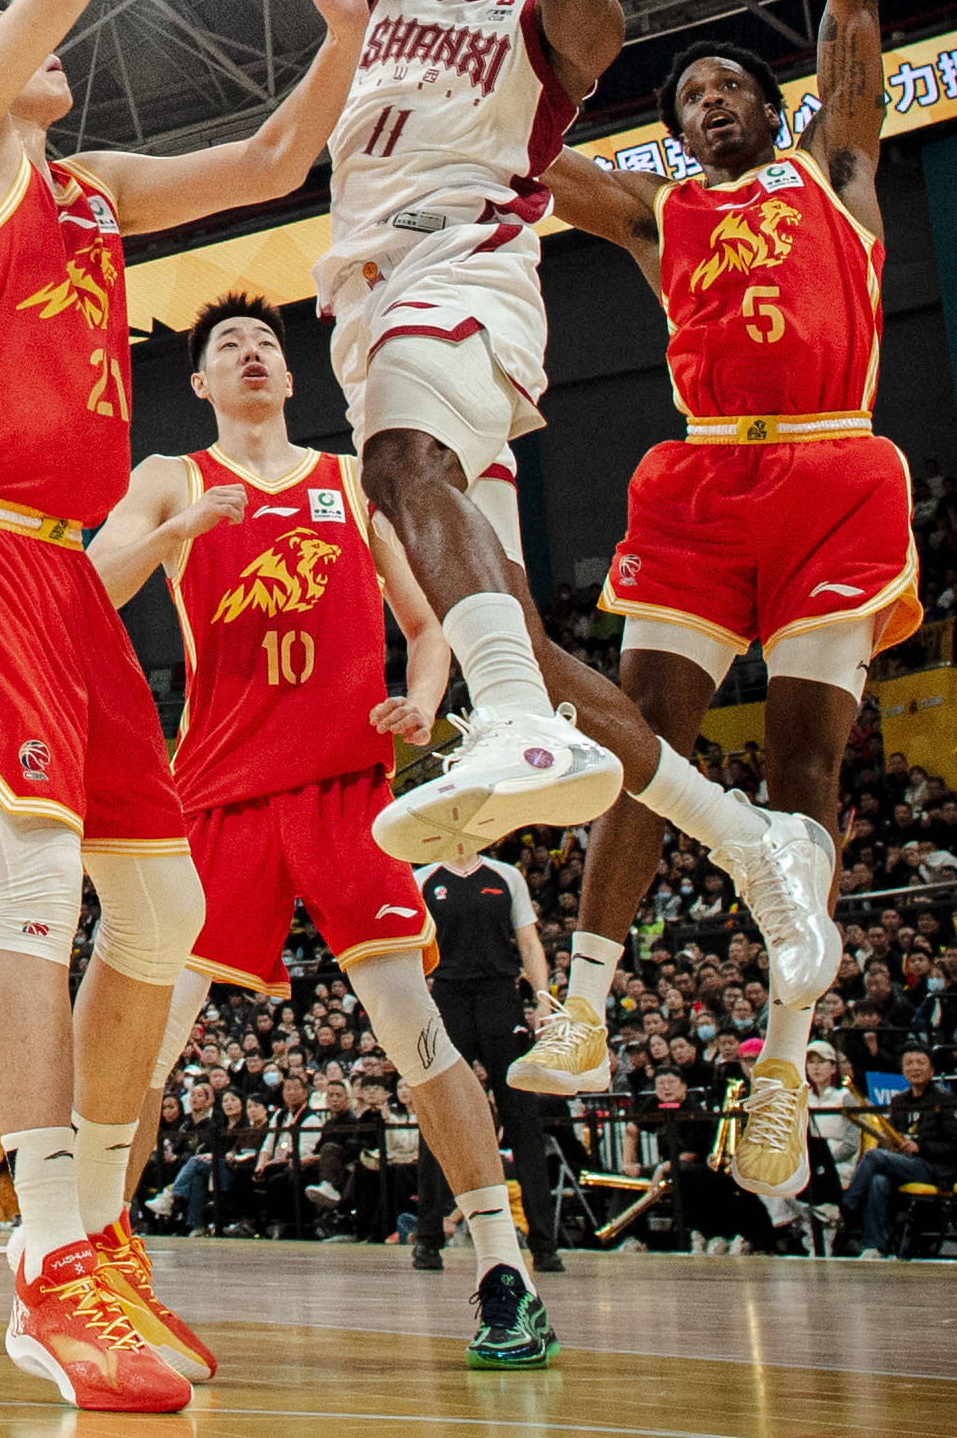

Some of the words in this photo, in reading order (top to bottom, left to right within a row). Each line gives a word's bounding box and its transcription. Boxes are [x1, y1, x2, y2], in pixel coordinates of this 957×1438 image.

[358, 14, 511, 98] SHANXI
[363, 105, 417, 159] 11
[741, 285, 786, 344] 5
[86, 348, 130, 423] 21
[261, 630, 315, 686] 10
